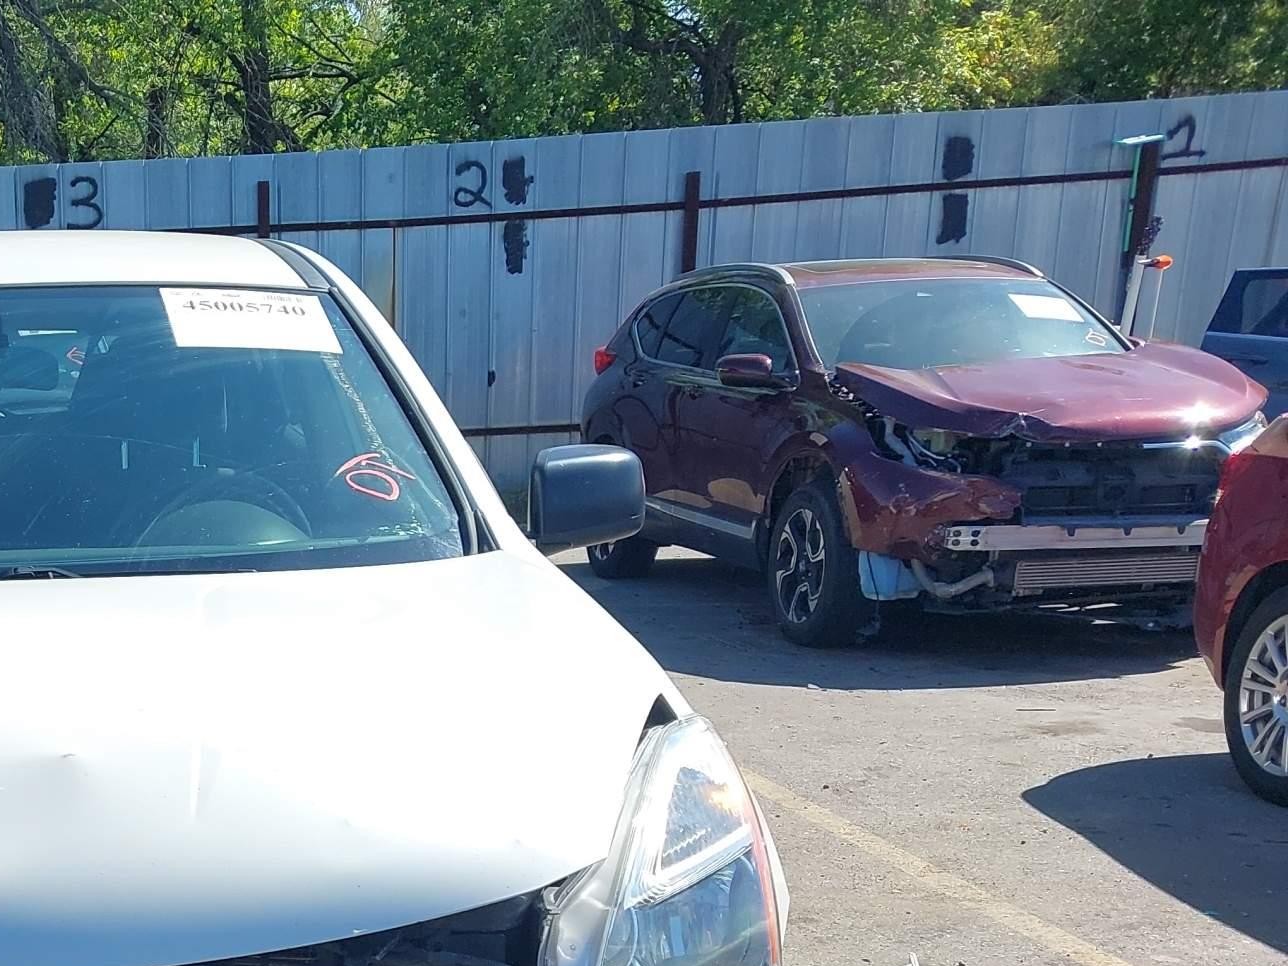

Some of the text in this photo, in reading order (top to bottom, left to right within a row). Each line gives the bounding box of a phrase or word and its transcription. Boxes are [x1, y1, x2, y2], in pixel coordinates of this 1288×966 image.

[67, 176, 103, 230] 3
[454, 160, 493, 209] 2
[182, 299, 307, 317] 45005740
